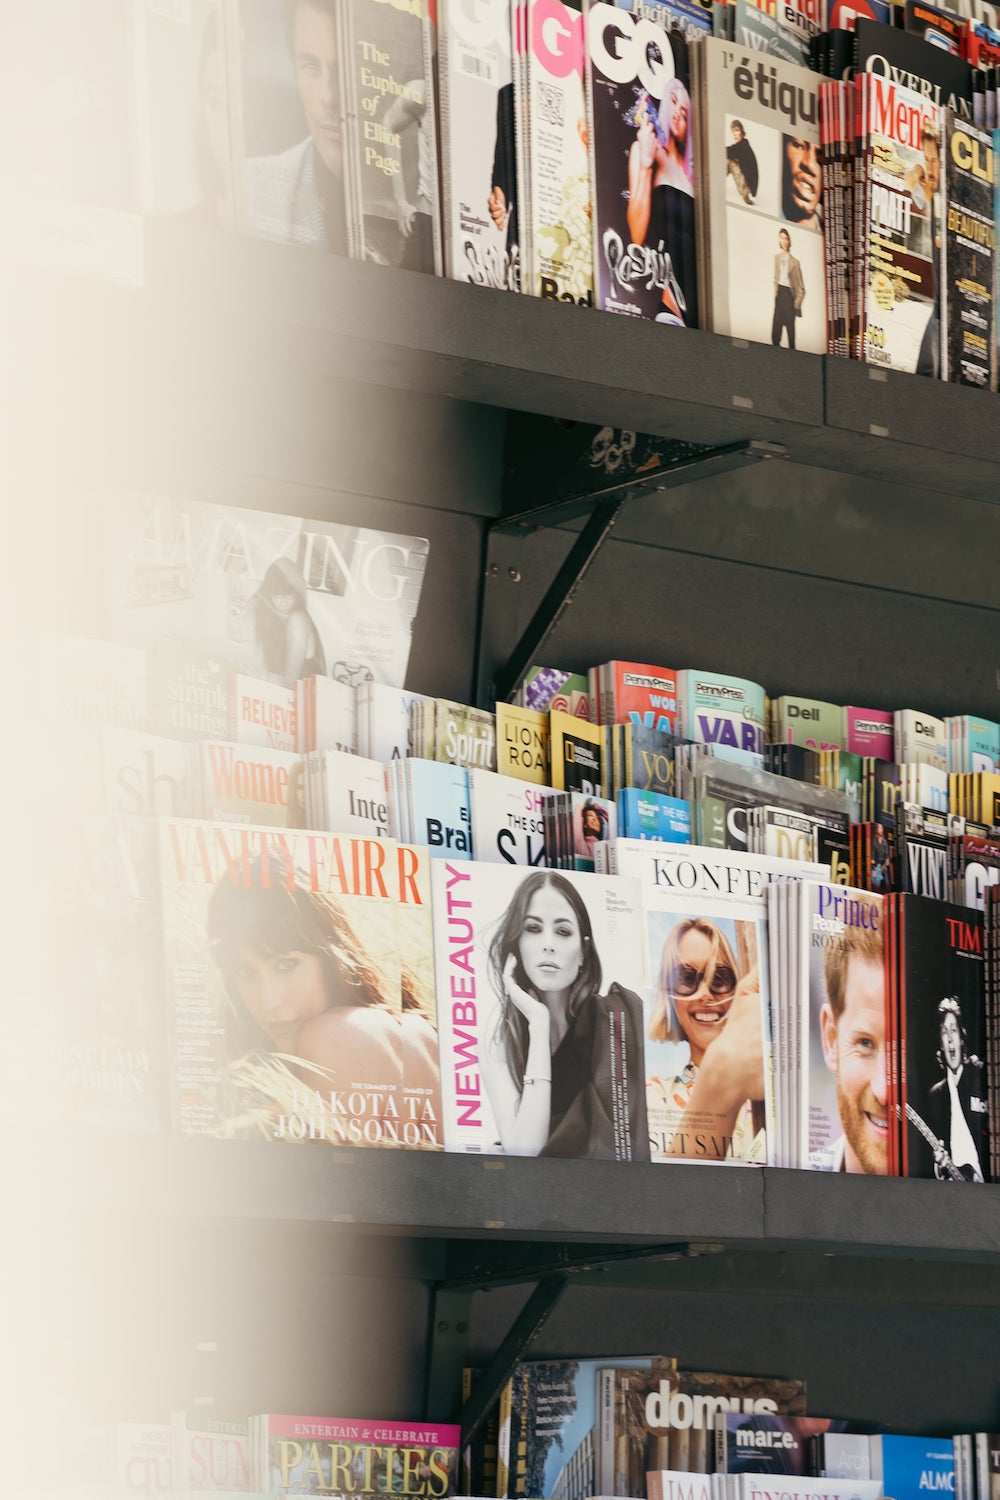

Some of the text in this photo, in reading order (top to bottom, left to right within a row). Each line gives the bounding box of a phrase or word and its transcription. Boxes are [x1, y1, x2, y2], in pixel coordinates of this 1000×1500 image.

[359, 41, 389, 66] The
[588, 2, 676, 100] GQ
[362, 97, 379, 116] of
[364, 122, 402, 148] Elliot
[366, 148, 400, 176] Page
[787, 704, 820, 721] Dell
[445, 719, 493, 768] Spirit
[915, 721, 935, 738] Dell
[507, 814, 526, 830] THE
[169, 824, 389, 898] VANITY FAIR
[819, 886, 879, 931] Prince
[445, 863, 483, 1127] NEWBEAUTY
[274, 1115, 399, 1144] JOHNSON
[645, 1379, 778, 1431] domus
[294, 1424, 438, 1444] ENTERTAIN & CELEBRATE
[277, 1440, 450, 1495] PARTIES
